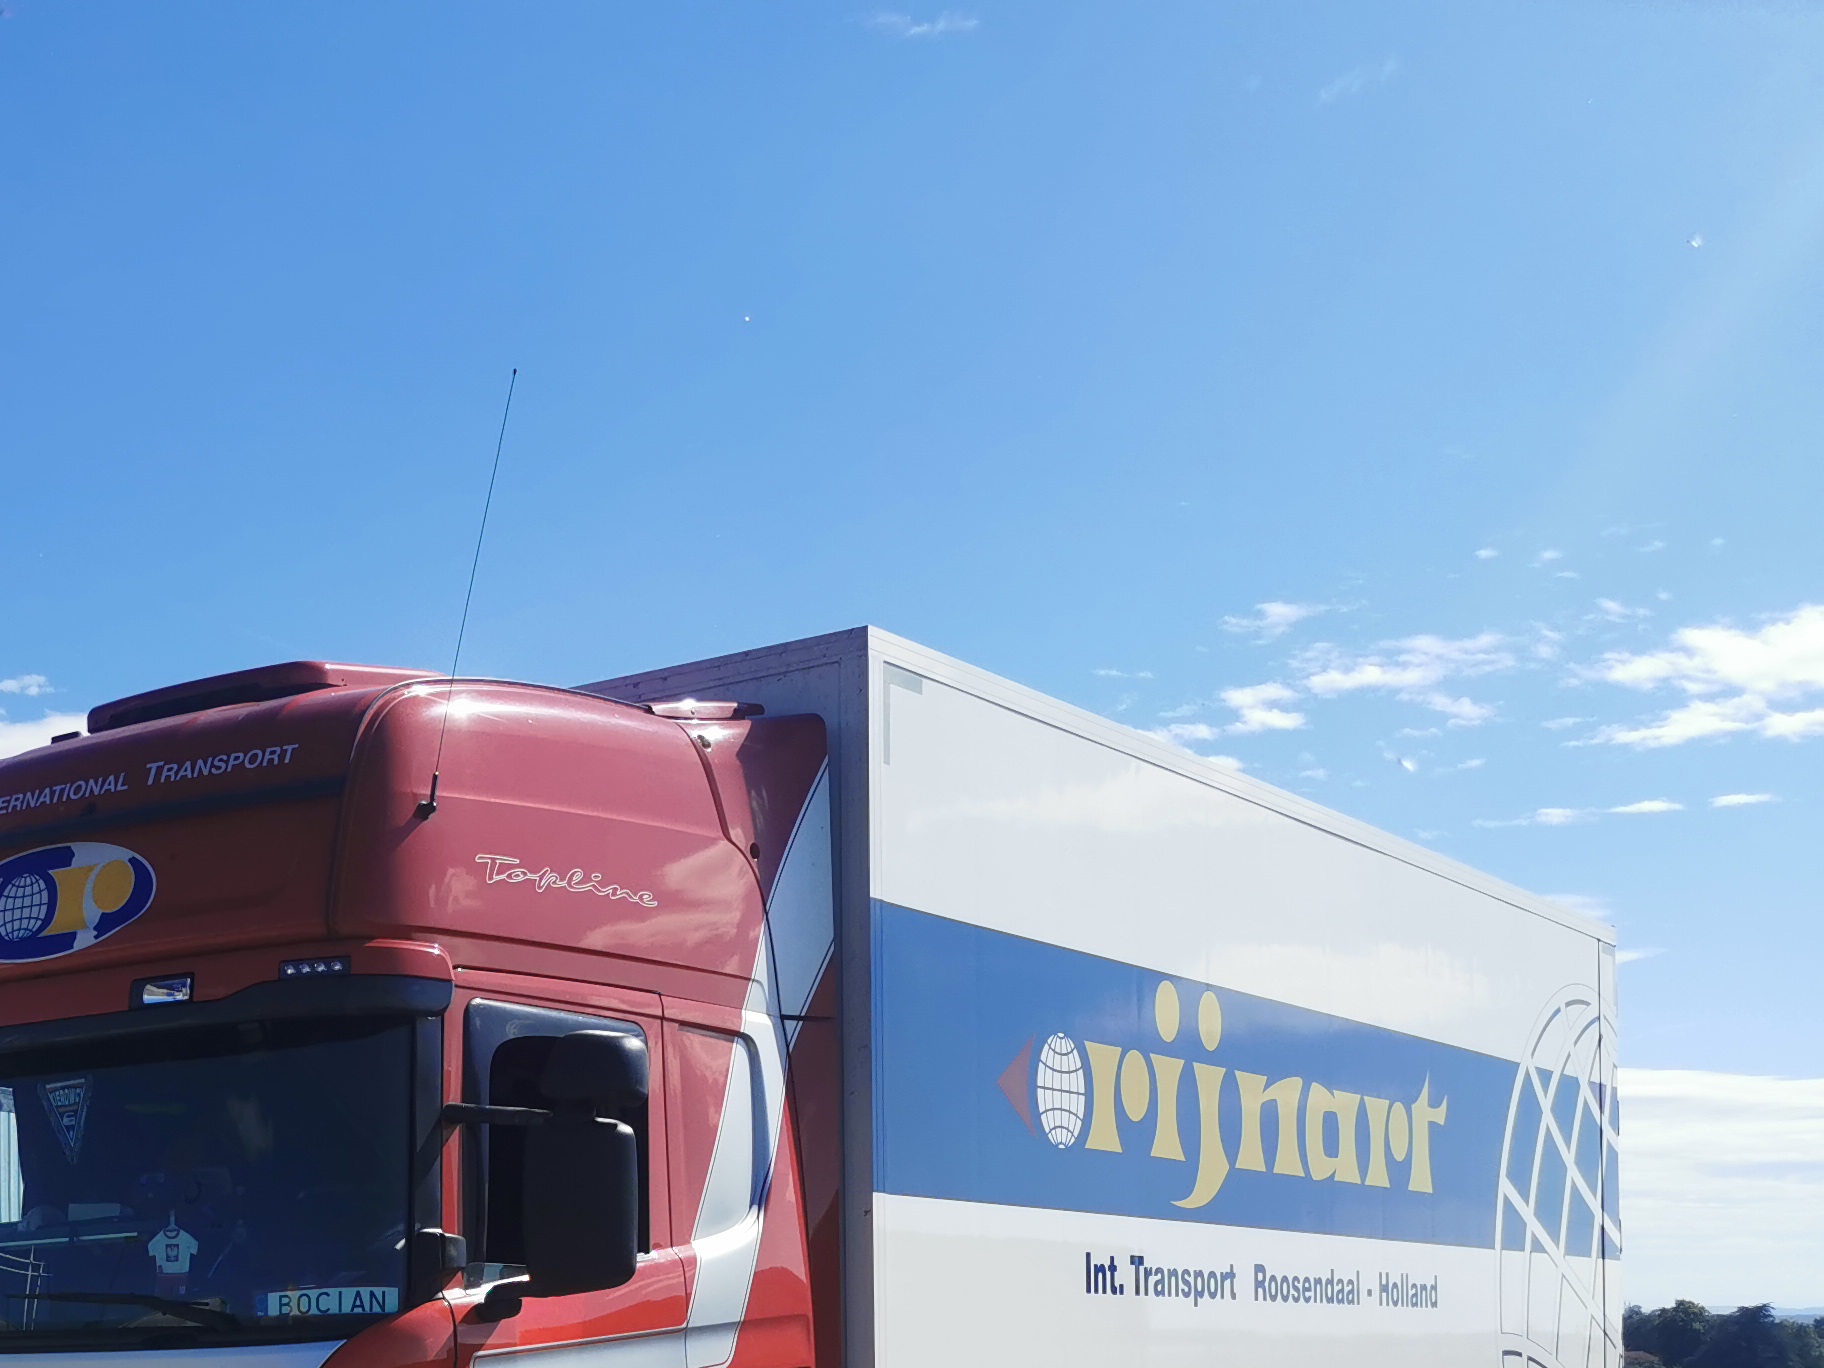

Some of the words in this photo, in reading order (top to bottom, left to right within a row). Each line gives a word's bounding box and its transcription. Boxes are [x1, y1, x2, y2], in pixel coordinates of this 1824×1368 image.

[145, 742, 300, 788] TRANSPORT
[474, 852, 659, 909] Topline
[1083, 979, 1448, 1209] rijnart
[278, 1290, 386, 1315] BOCIAN
[1084, 1251, 1125, 1296] Int.
[1129, 1253, 1238, 1308] Transport
[1252, 1262, 1362, 1307] Roosendaal
[1378, 1269, 1439, 1309] Holland
